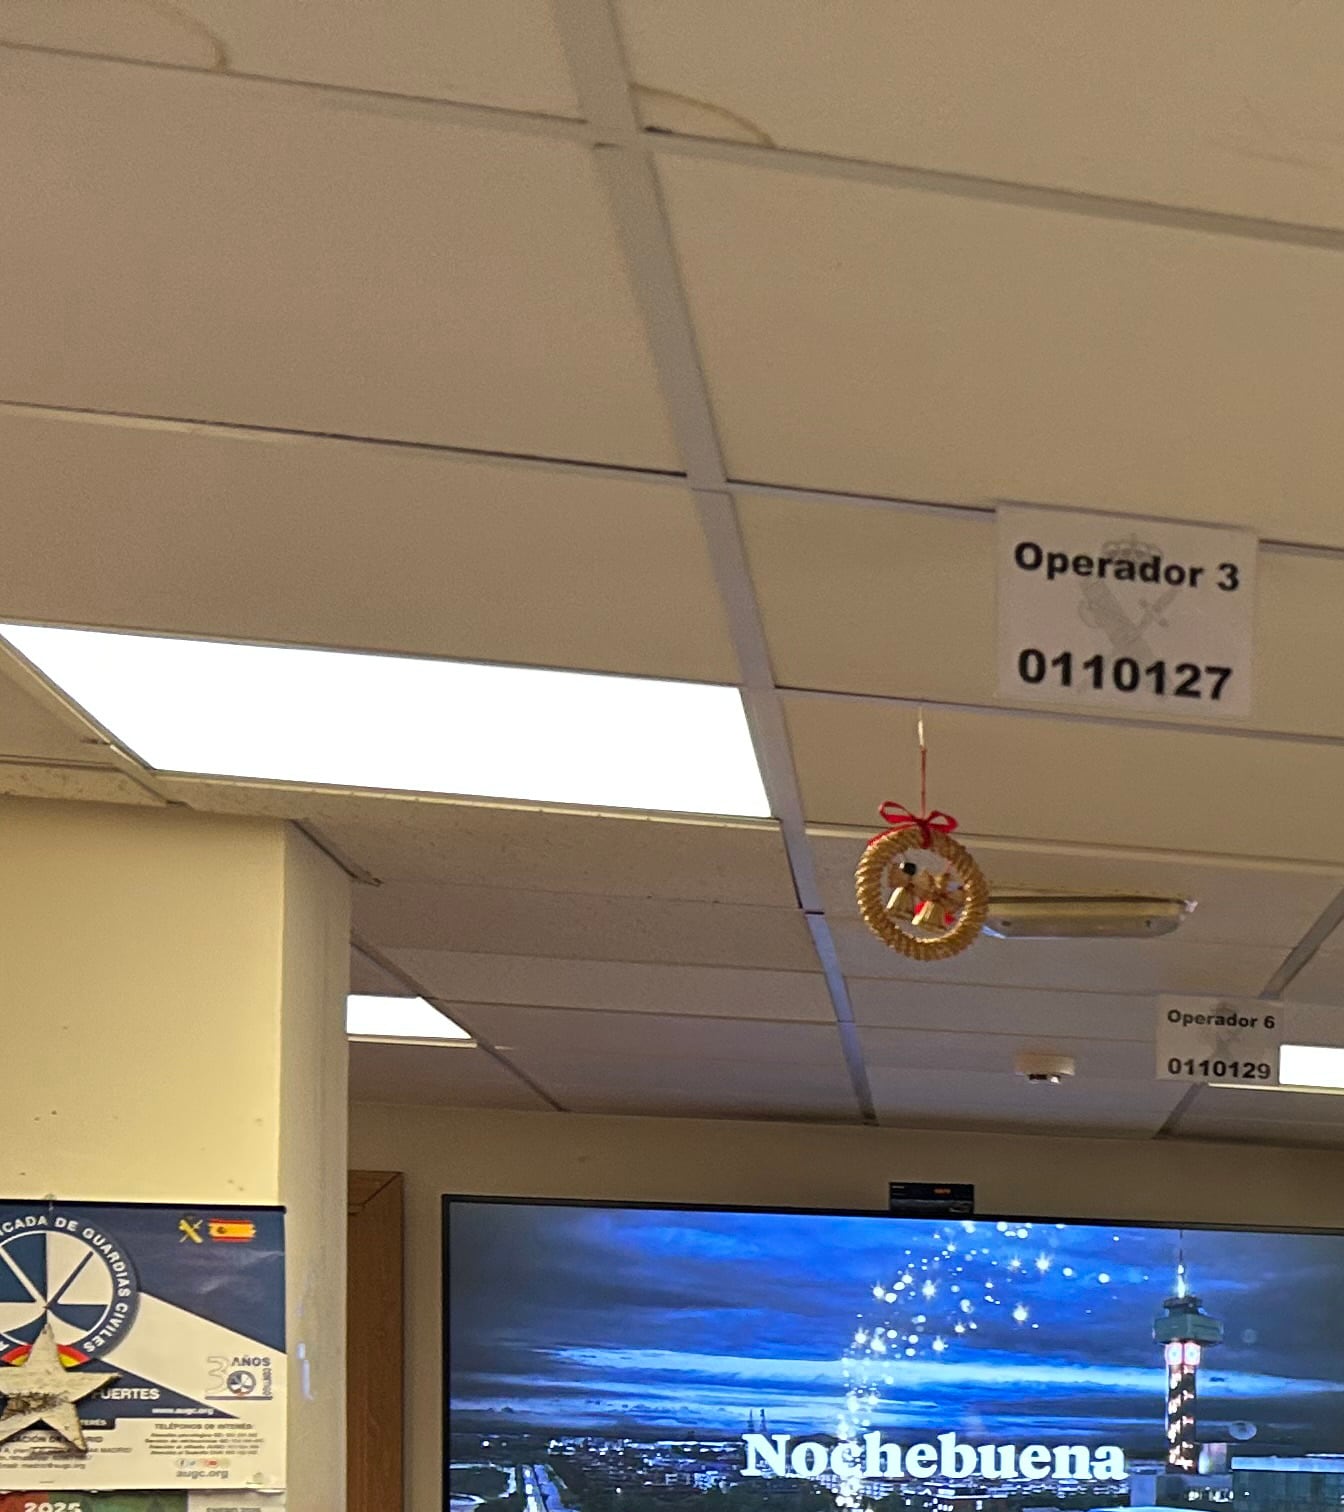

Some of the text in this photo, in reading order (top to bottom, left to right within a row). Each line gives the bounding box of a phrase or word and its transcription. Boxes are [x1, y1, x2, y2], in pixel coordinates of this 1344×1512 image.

[1014, 541, 1240, 592] Operador 3
[1018, 648, 1233, 700] 0110127
[1167, 1009, 1276, 1029] Operador 6
[1167, 1057, 1272, 1079] 0110129
[54, 1217, 79, 1232] DE
[82, 1227, 131, 1297] GUARDIAS
[82, 1303, 129, 1353] CIVILES
[231, 1354, 271, 1367] AÑOS
[741, 1430, 1130, 1481] Nochebuena
